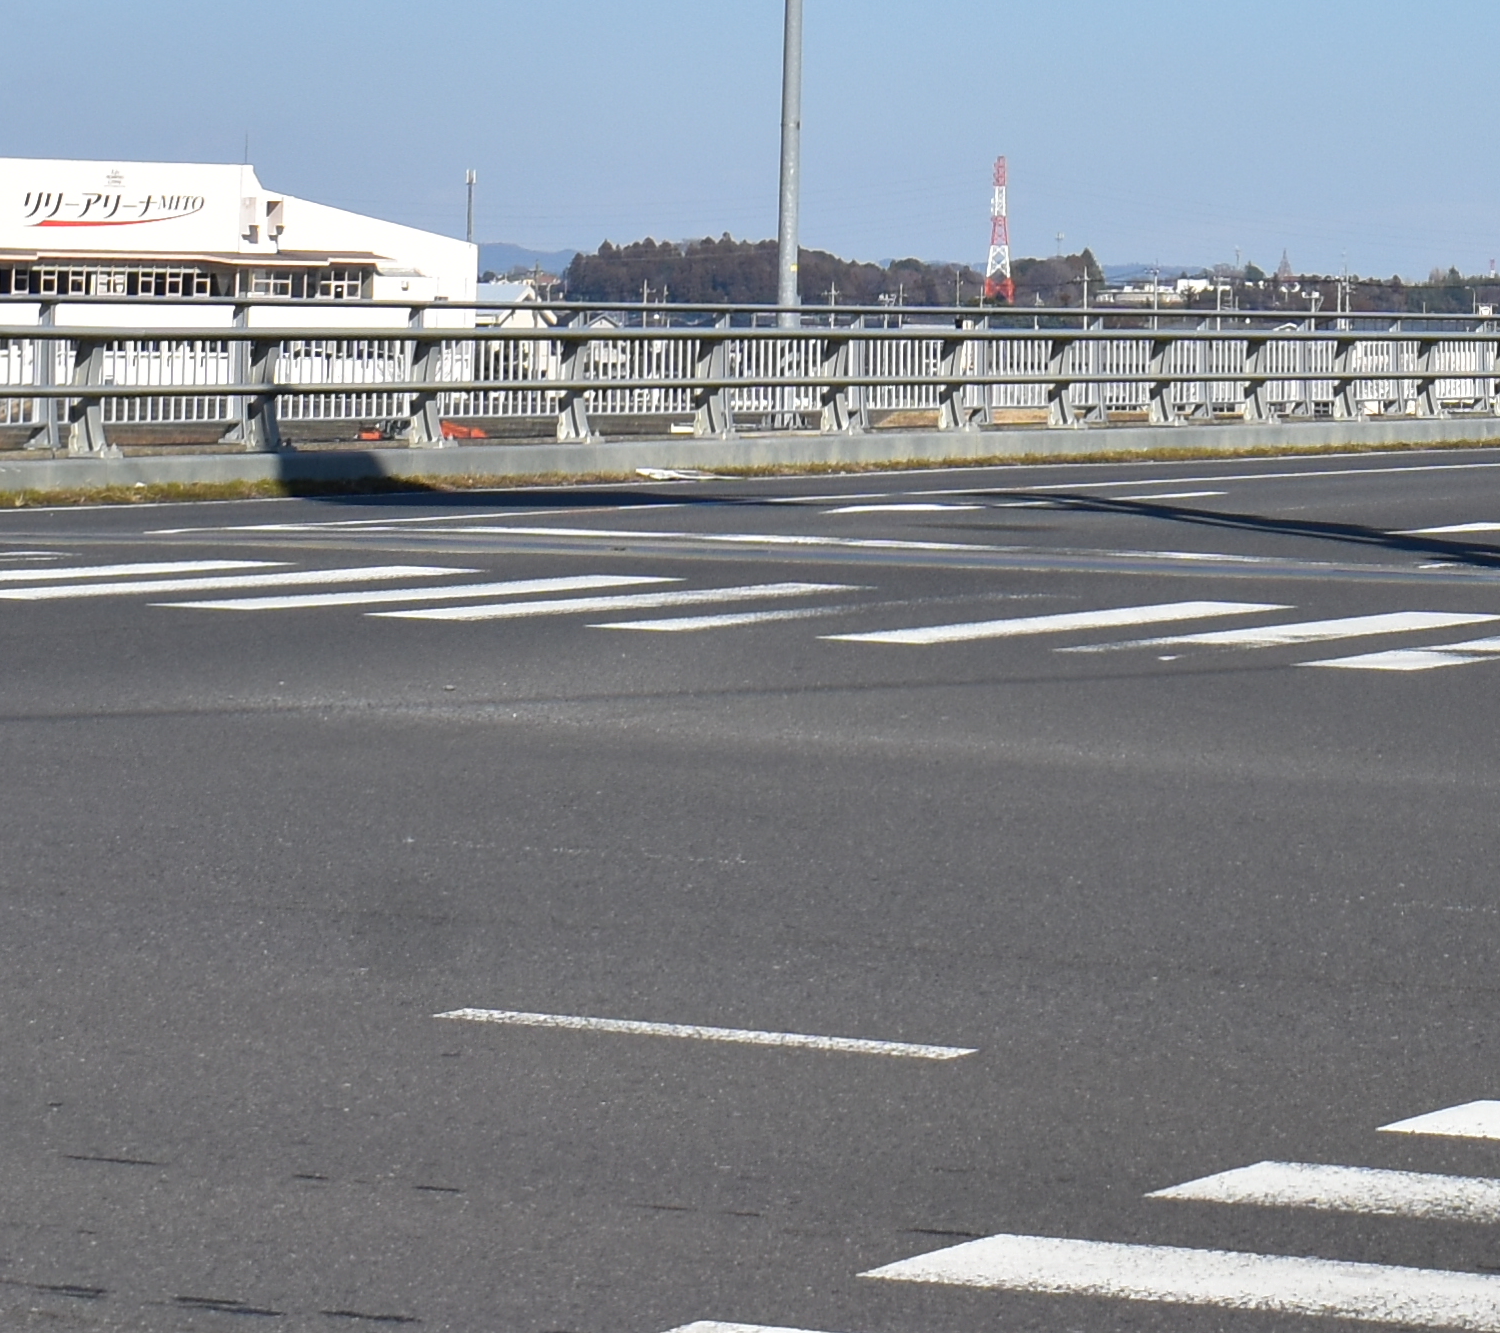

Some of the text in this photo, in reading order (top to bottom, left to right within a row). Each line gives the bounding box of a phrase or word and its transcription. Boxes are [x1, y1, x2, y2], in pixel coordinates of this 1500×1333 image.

[23, 191, 205, 219] リリーアリーナMITO
